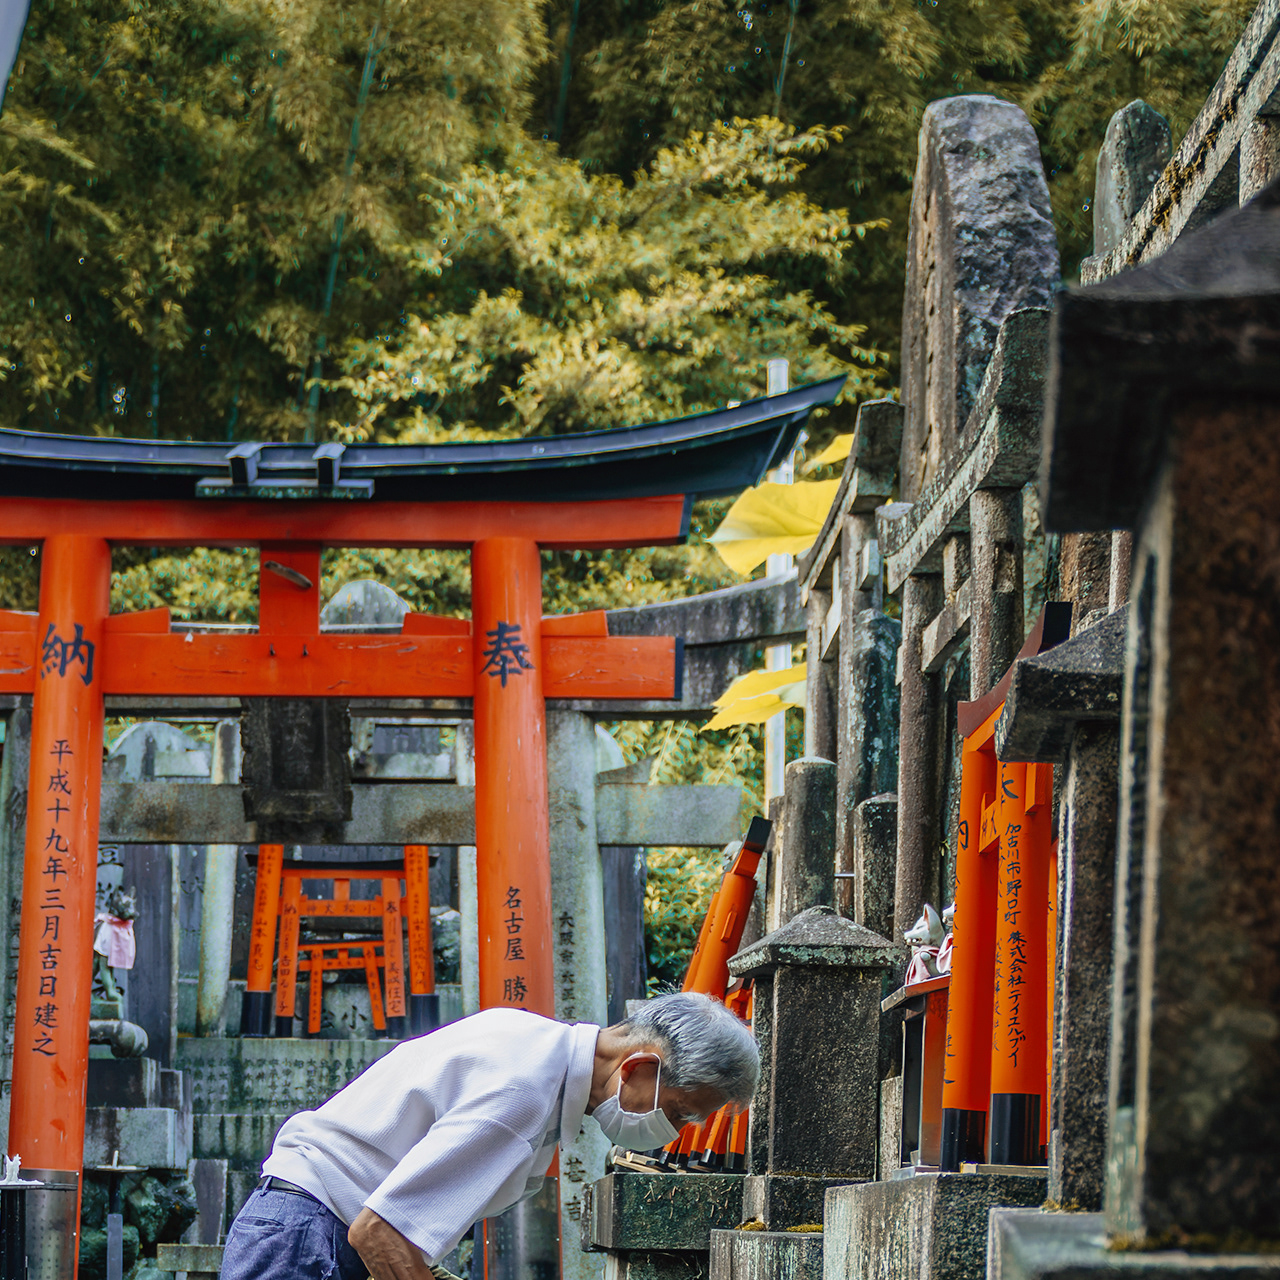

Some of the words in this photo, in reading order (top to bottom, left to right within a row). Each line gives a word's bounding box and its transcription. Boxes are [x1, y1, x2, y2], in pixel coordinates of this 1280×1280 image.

[41, 624, 95, 686] 納
[482, 622, 535, 687] 奉
[31, 740, 74, 1056] 平成十九年三月吉日建之
[1003, 822, 1024, 926] 加古川市野口町
[503, 886, 525, 961] 名古屋
[503, 975, 528, 1003] 勝
